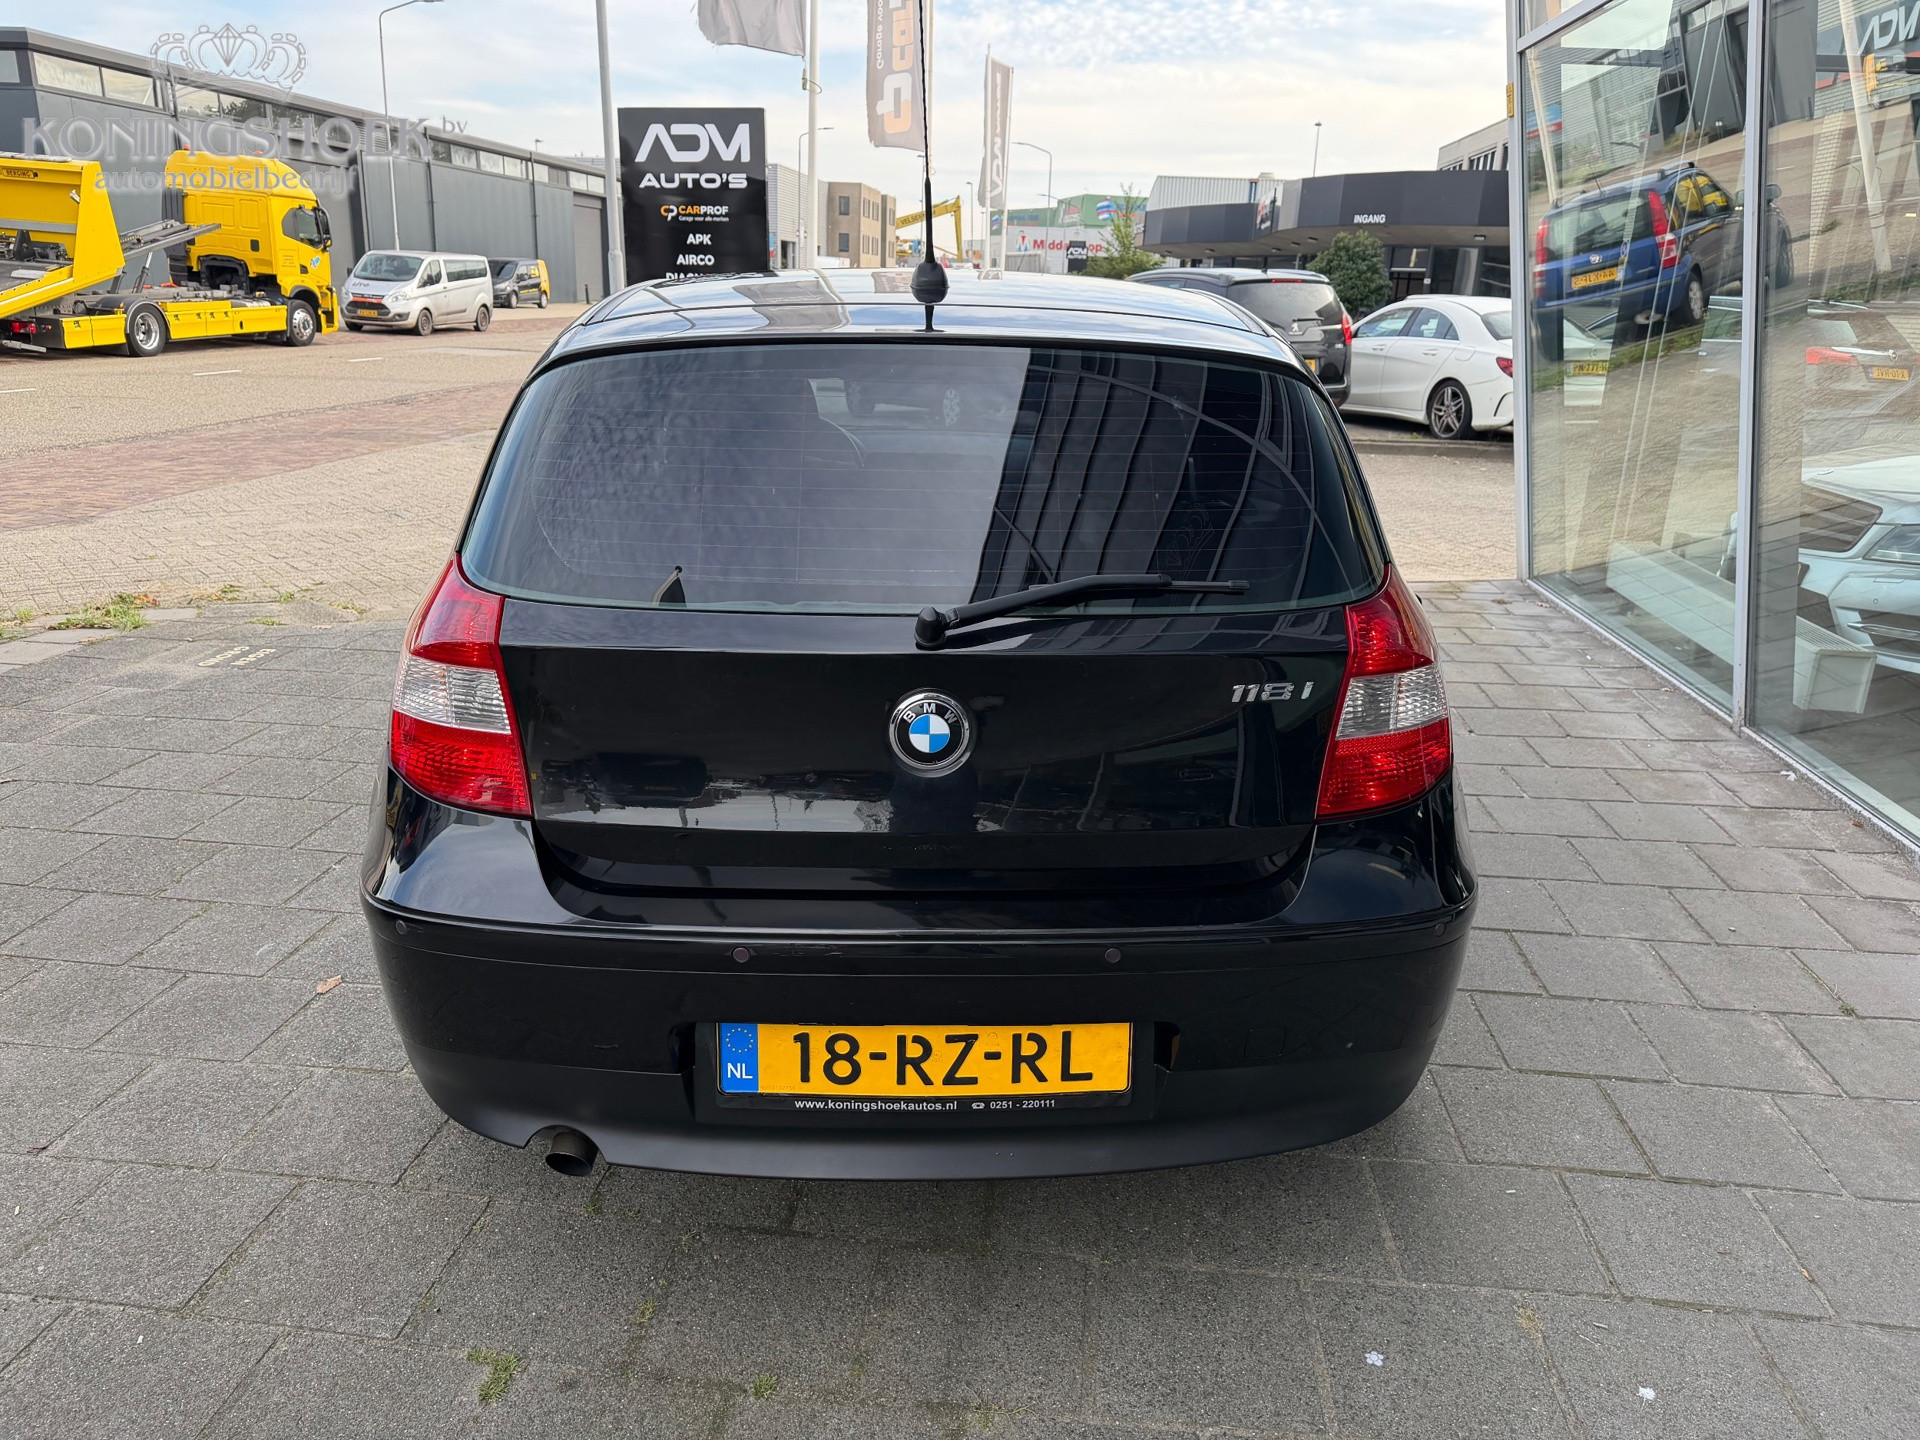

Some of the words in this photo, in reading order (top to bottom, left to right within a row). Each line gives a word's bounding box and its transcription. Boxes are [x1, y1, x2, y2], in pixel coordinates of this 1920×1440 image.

[634, 123, 750, 163] ADM
[638, 173, 748, 189] AUTO'S
[679, 205, 729, 215] CARPROF
[1353, 213, 1387, 224] INGANG
[686, 233, 712, 245] APK
[676, 254, 715, 265] AIRCO
[902, 702, 959, 724] BMW
[793, 1030, 1094, 1086] 18-RZ-RL
[727, 1062, 753, 1080] NL
[794, 1099, 957, 1112] www.koningshoekautos.nl
[989, 1100, 1013, 1109] 0251
[1022, 1100, 1055, 1109] 220111
